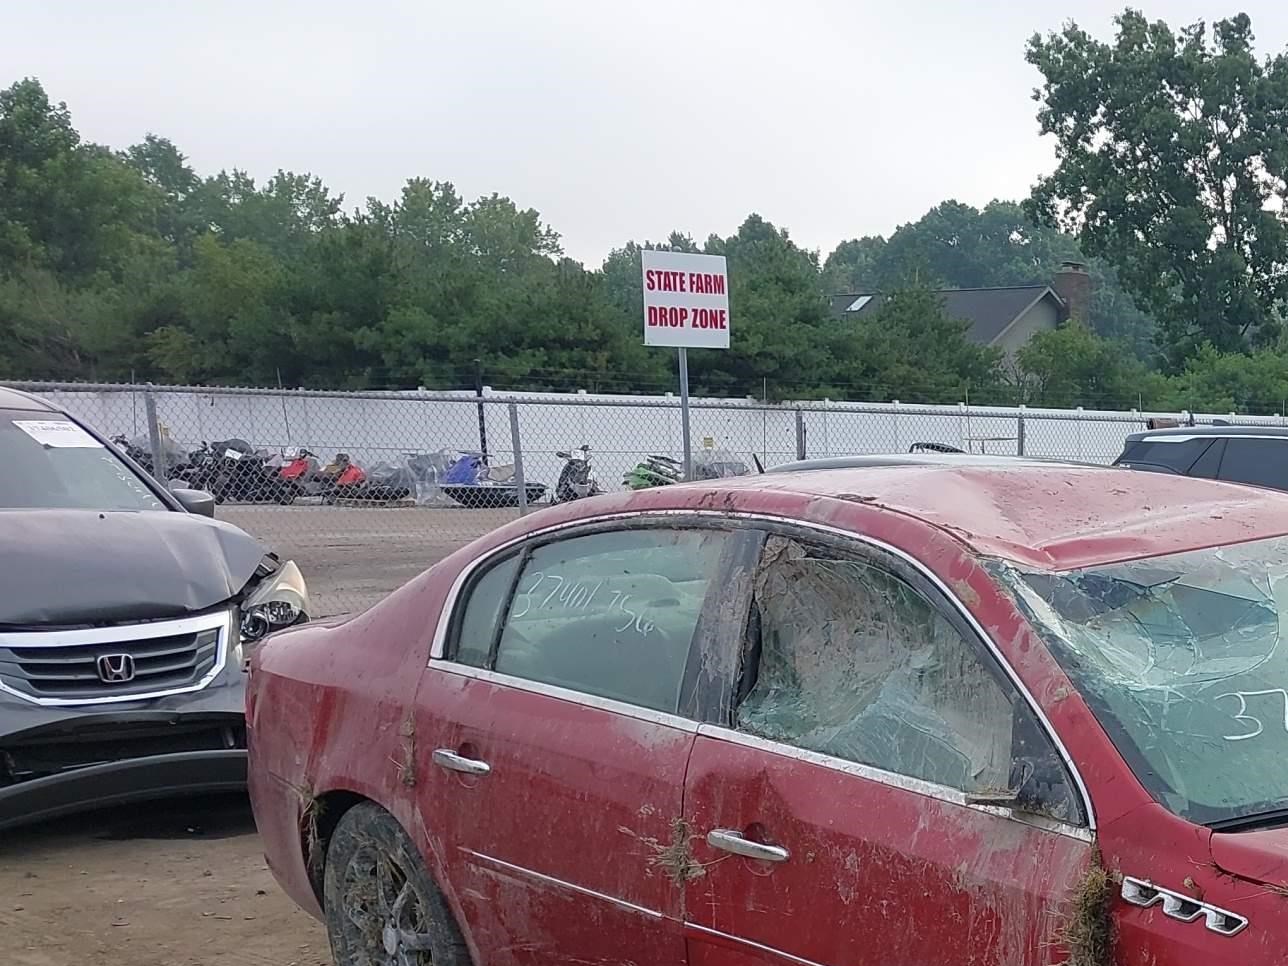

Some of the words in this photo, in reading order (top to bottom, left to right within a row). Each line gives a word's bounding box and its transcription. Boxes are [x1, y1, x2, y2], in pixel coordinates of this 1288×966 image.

[646, 269, 686, 292] STATE
[688, 272, 725, 294] FARM
[648, 305, 688, 328] DROP
[691, 308, 727, 330] ZONE
